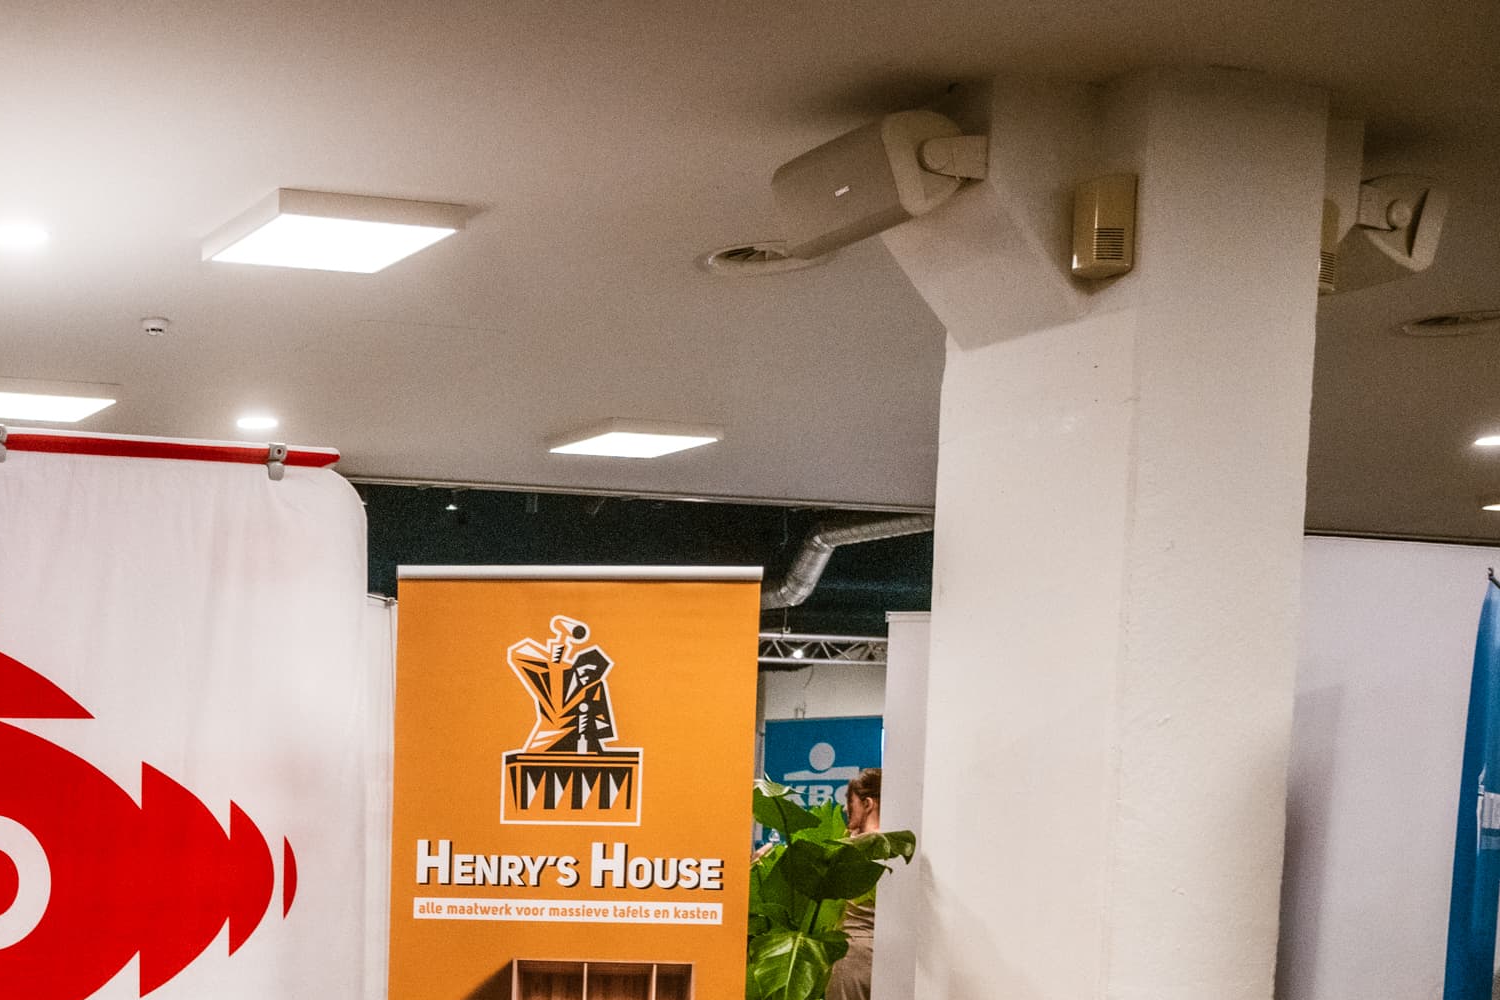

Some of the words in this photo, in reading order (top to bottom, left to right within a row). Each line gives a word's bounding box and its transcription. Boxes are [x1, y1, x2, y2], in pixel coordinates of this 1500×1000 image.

[416, 839, 580, 887] HENRY'S
[590, 842, 724, 890] HOUSE
[418, 902, 443, 915] alle
[447, 902, 512, 917] maatwerk
[516, 906, 546, 917] voor
[548, 905, 610, 919] massieve
[613, 904, 651, 920] tafels
[653, 909, 671, 919] en
[674, 907, 718, 921] kasten
